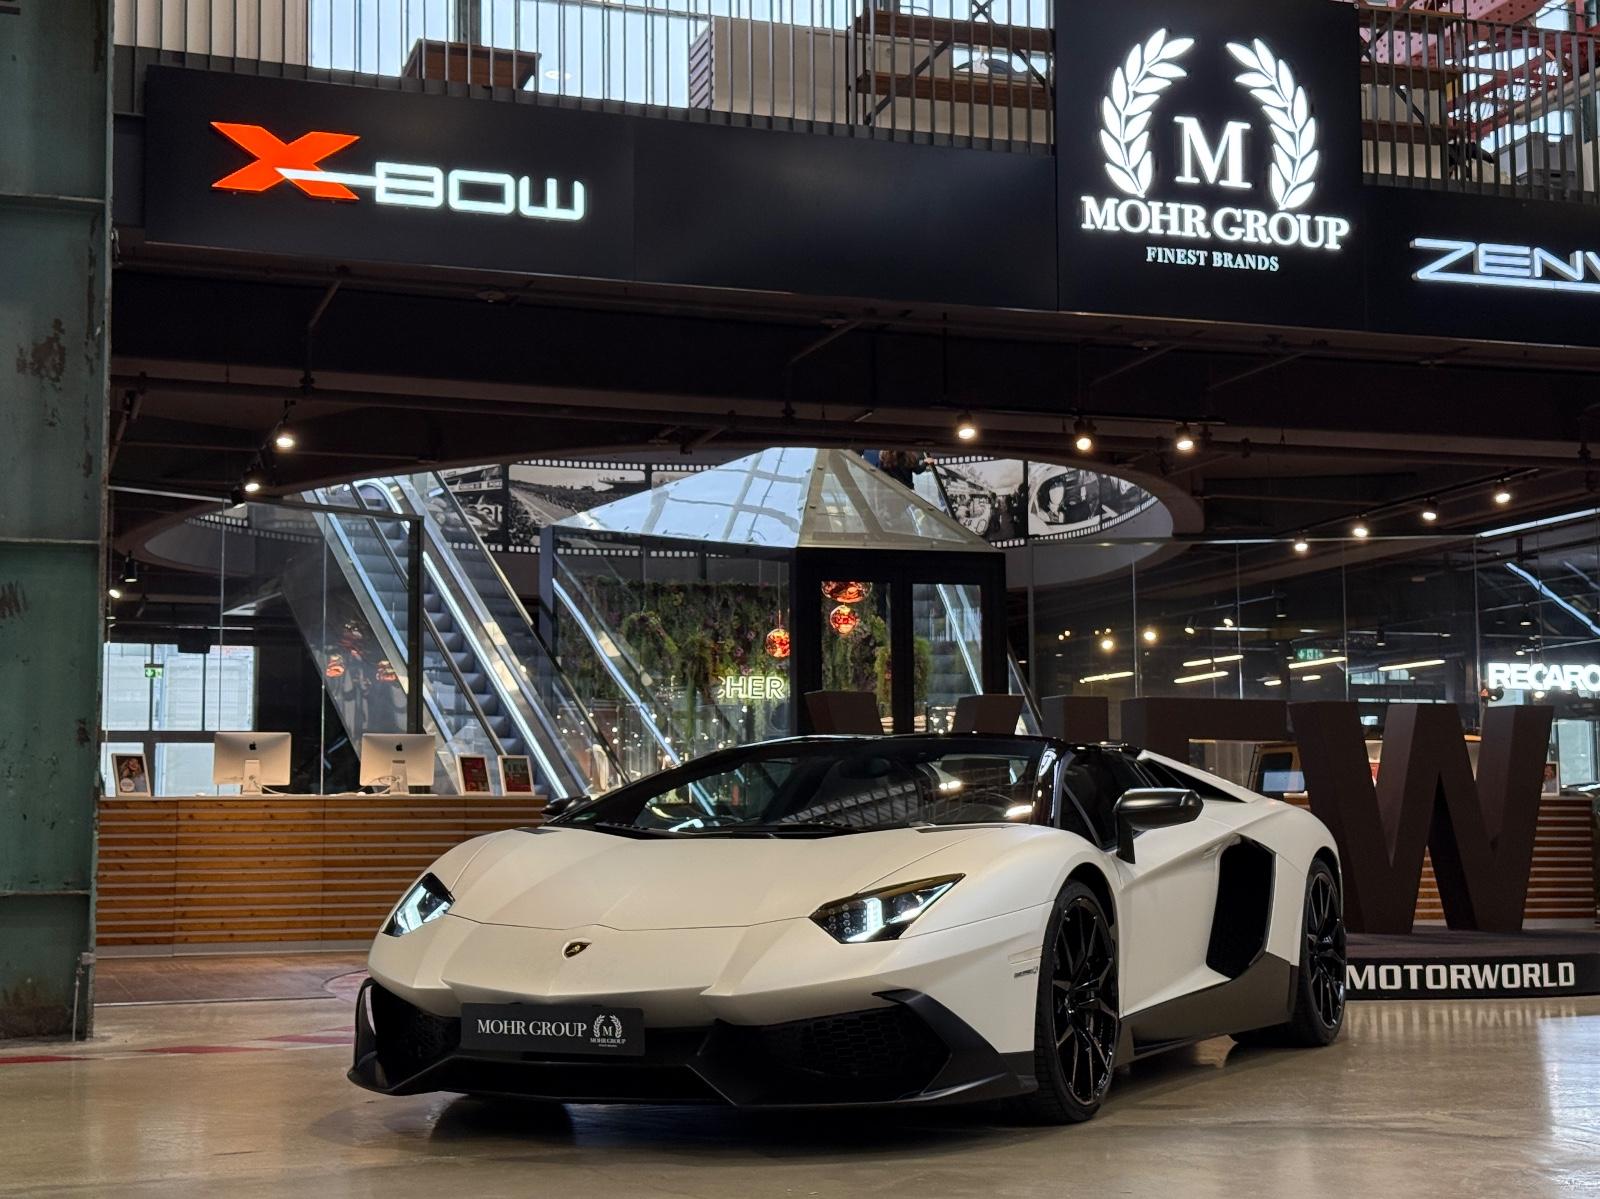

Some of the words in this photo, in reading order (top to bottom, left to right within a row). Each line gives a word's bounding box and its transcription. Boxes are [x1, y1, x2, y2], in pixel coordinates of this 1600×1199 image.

[1173, 116, 1252, 189] M
[1080, 195, 1211, 239] MOHR
[1212, 206, 1351, 250] GROUP
[1145, 246, 1208, 266] FINEST
[1212, 250, 1280, 272] BRANDS
[1410, 237, 1600, 292] ZEN
[1487, 662, 1600, 691] RECARO
[1345, 962, 1575, 990] MOTORWORLD
[477, 1018, 528, 1035] MOHR
[529, 1021, 587, 1037] GROUP
[602, 1025, 613, 1036] M
